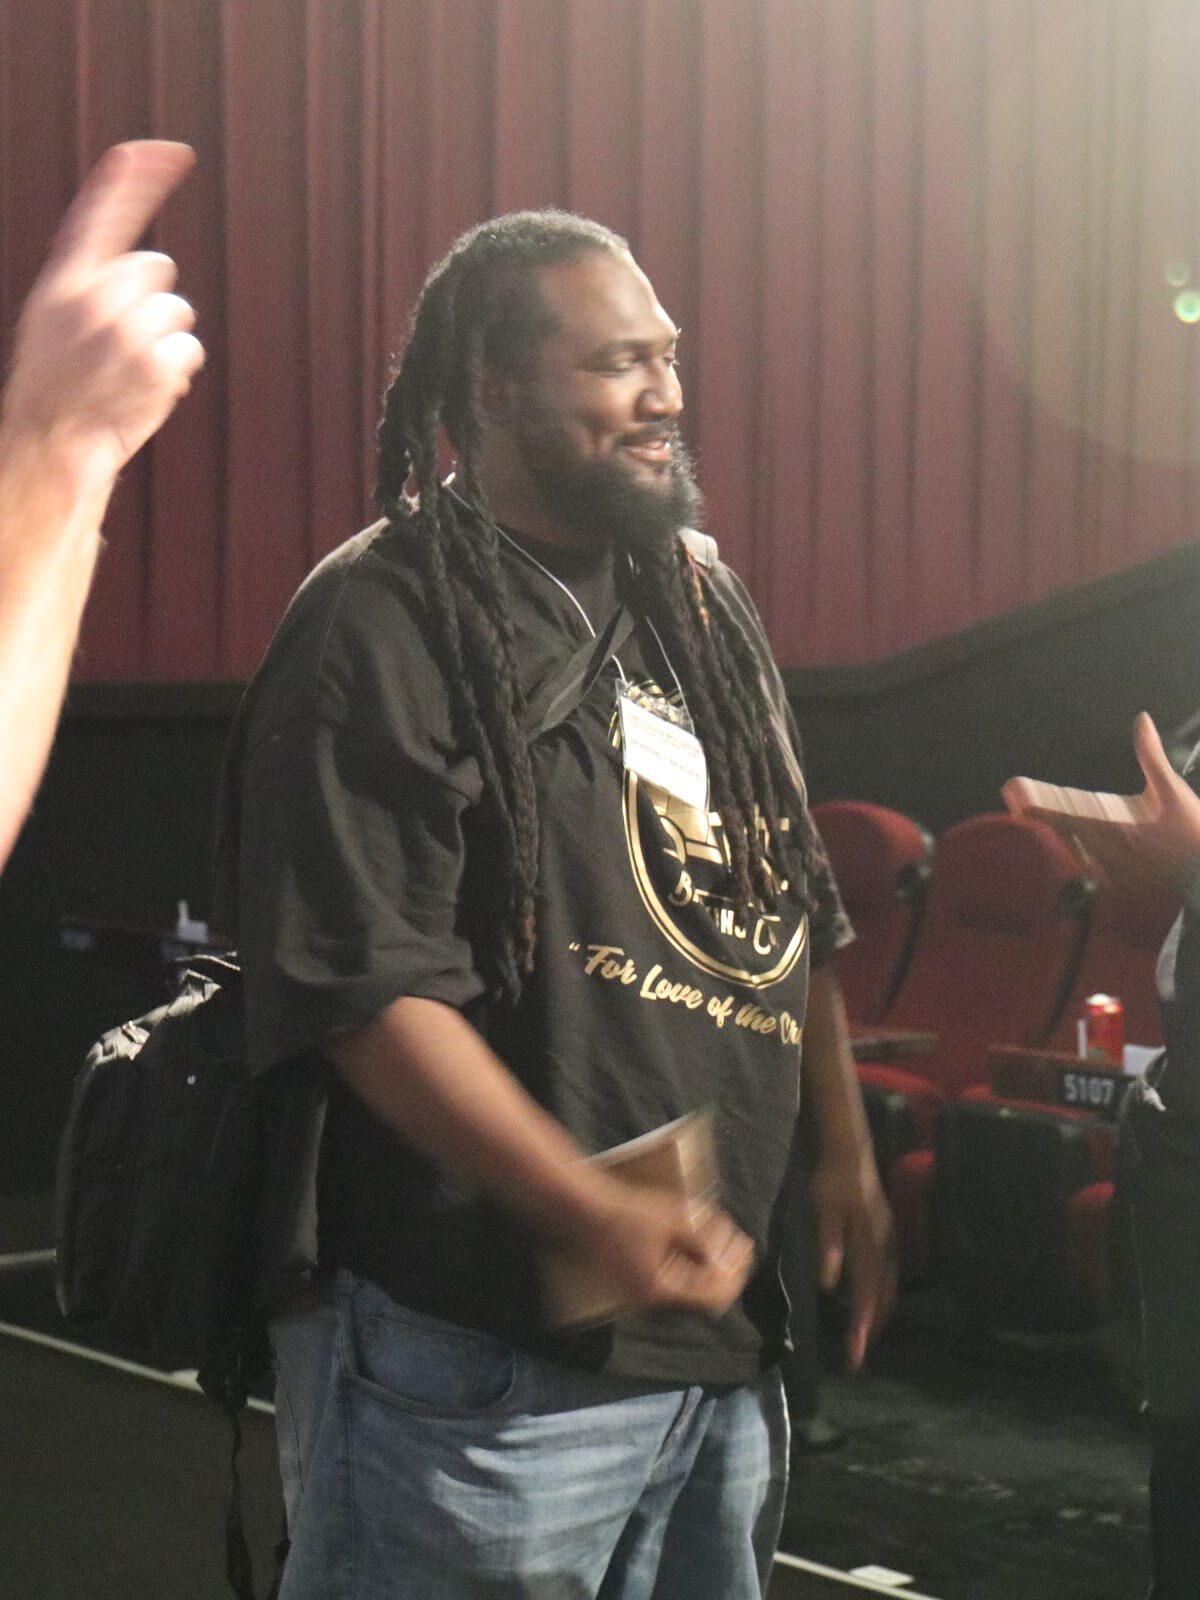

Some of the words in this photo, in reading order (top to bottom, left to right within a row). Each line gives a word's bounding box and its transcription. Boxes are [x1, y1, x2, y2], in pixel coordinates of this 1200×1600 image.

[640, 963, 703, 1009] Love
[706, 995, 735, 1028] of
[735, 1003, 776, 1034] the
